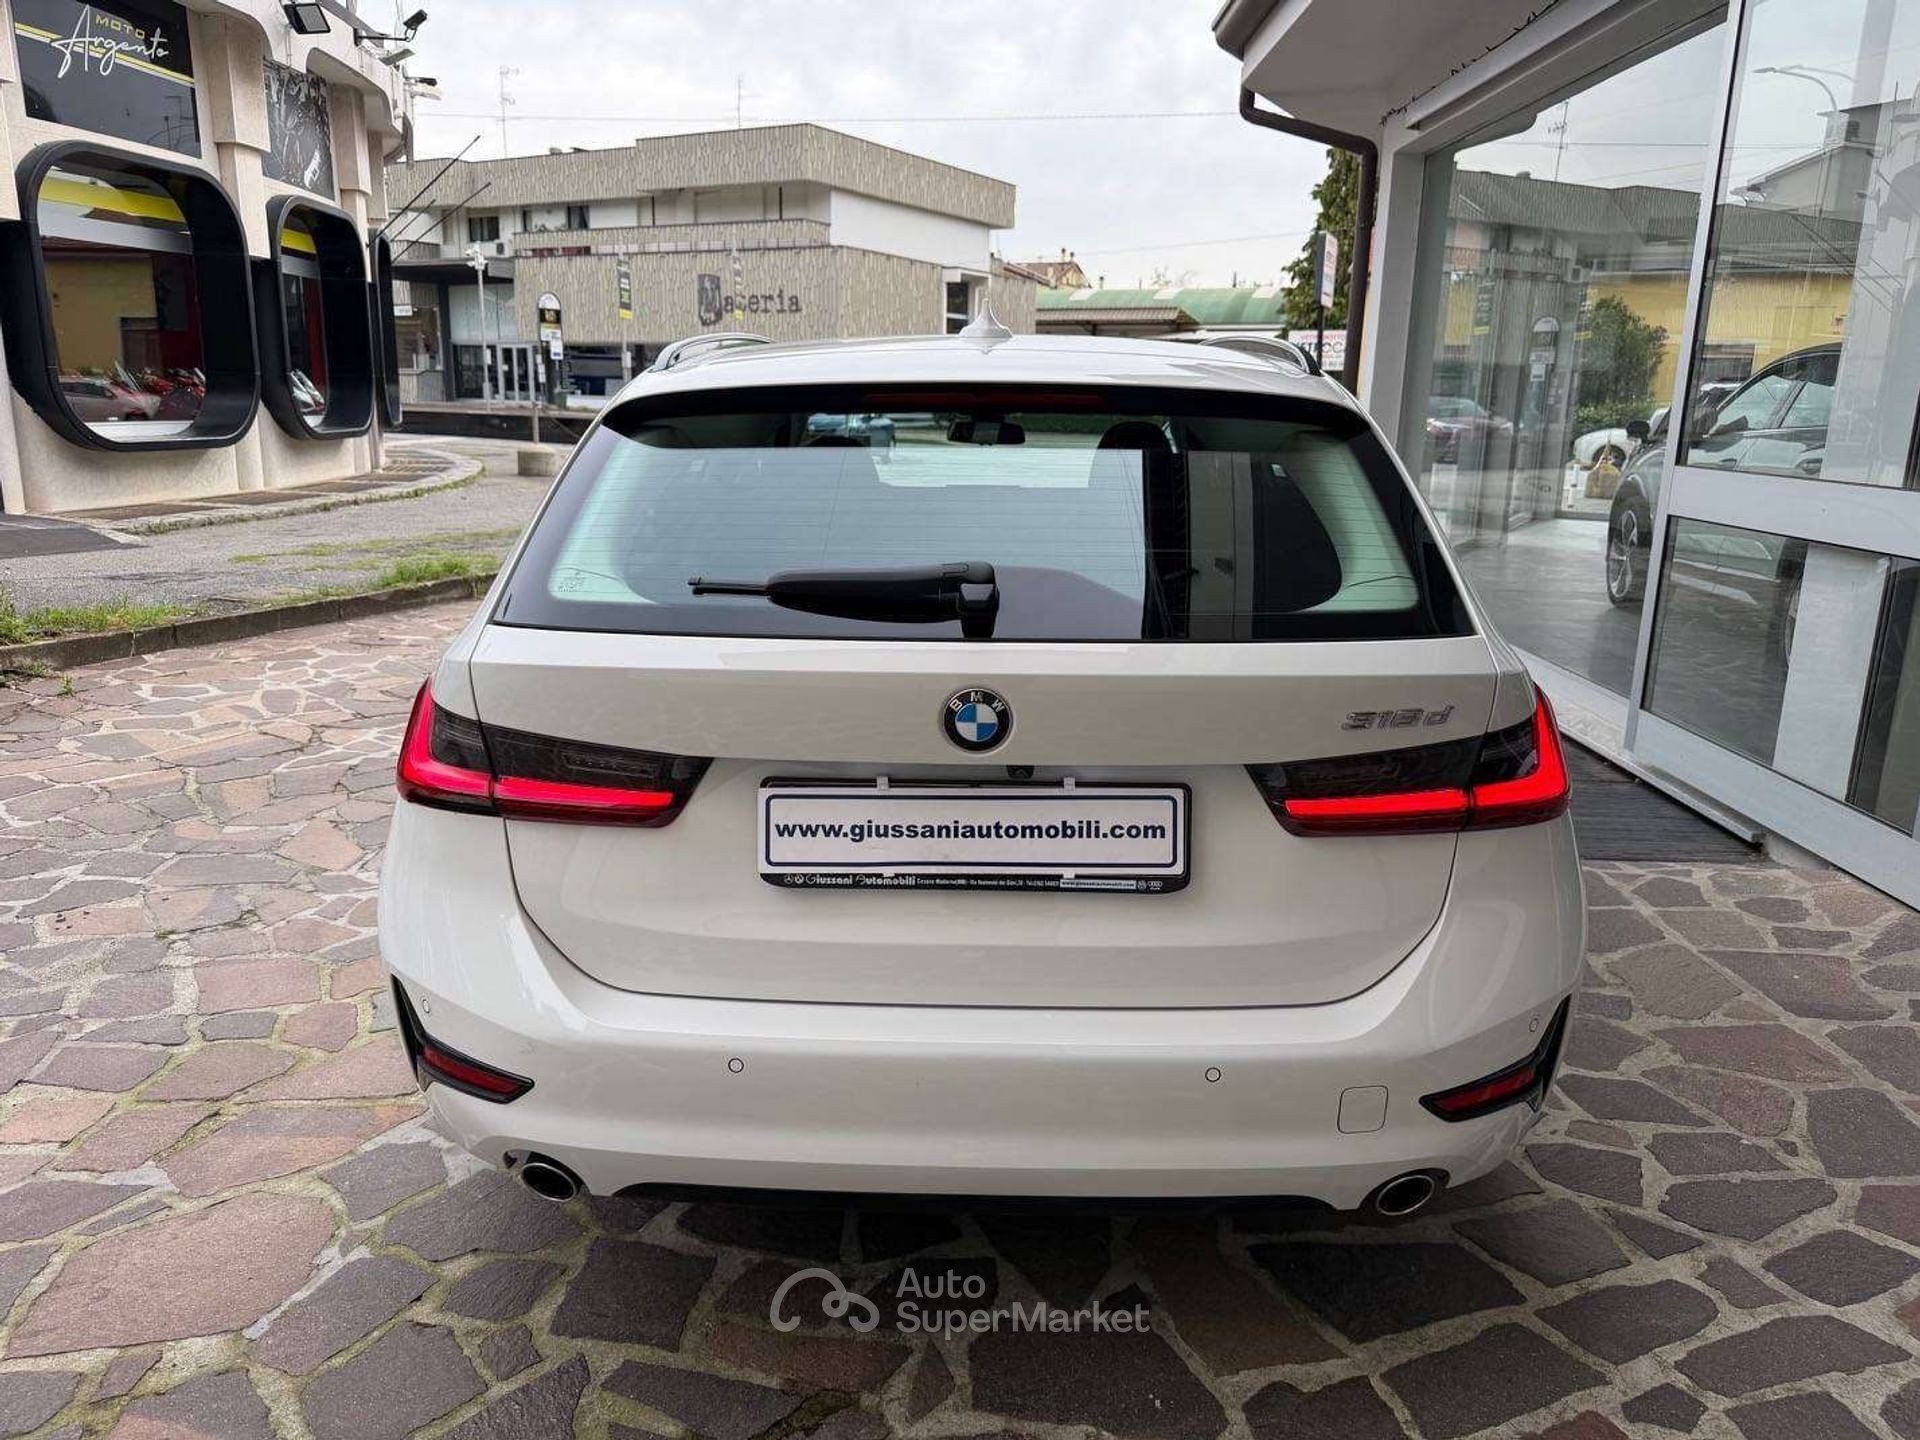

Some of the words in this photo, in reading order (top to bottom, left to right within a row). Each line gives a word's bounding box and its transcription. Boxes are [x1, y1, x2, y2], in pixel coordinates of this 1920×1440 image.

[95, 14, 146, 39] MOTO
[51, 4, 169, 79] Argento
[949, 690, 1006, 713] BMW
[1341, 703, 1456, 731] 318d
[774, 820, 1166, 842] www.giussaniautomobili.com
[805, 873, 853, 885] Giussani
